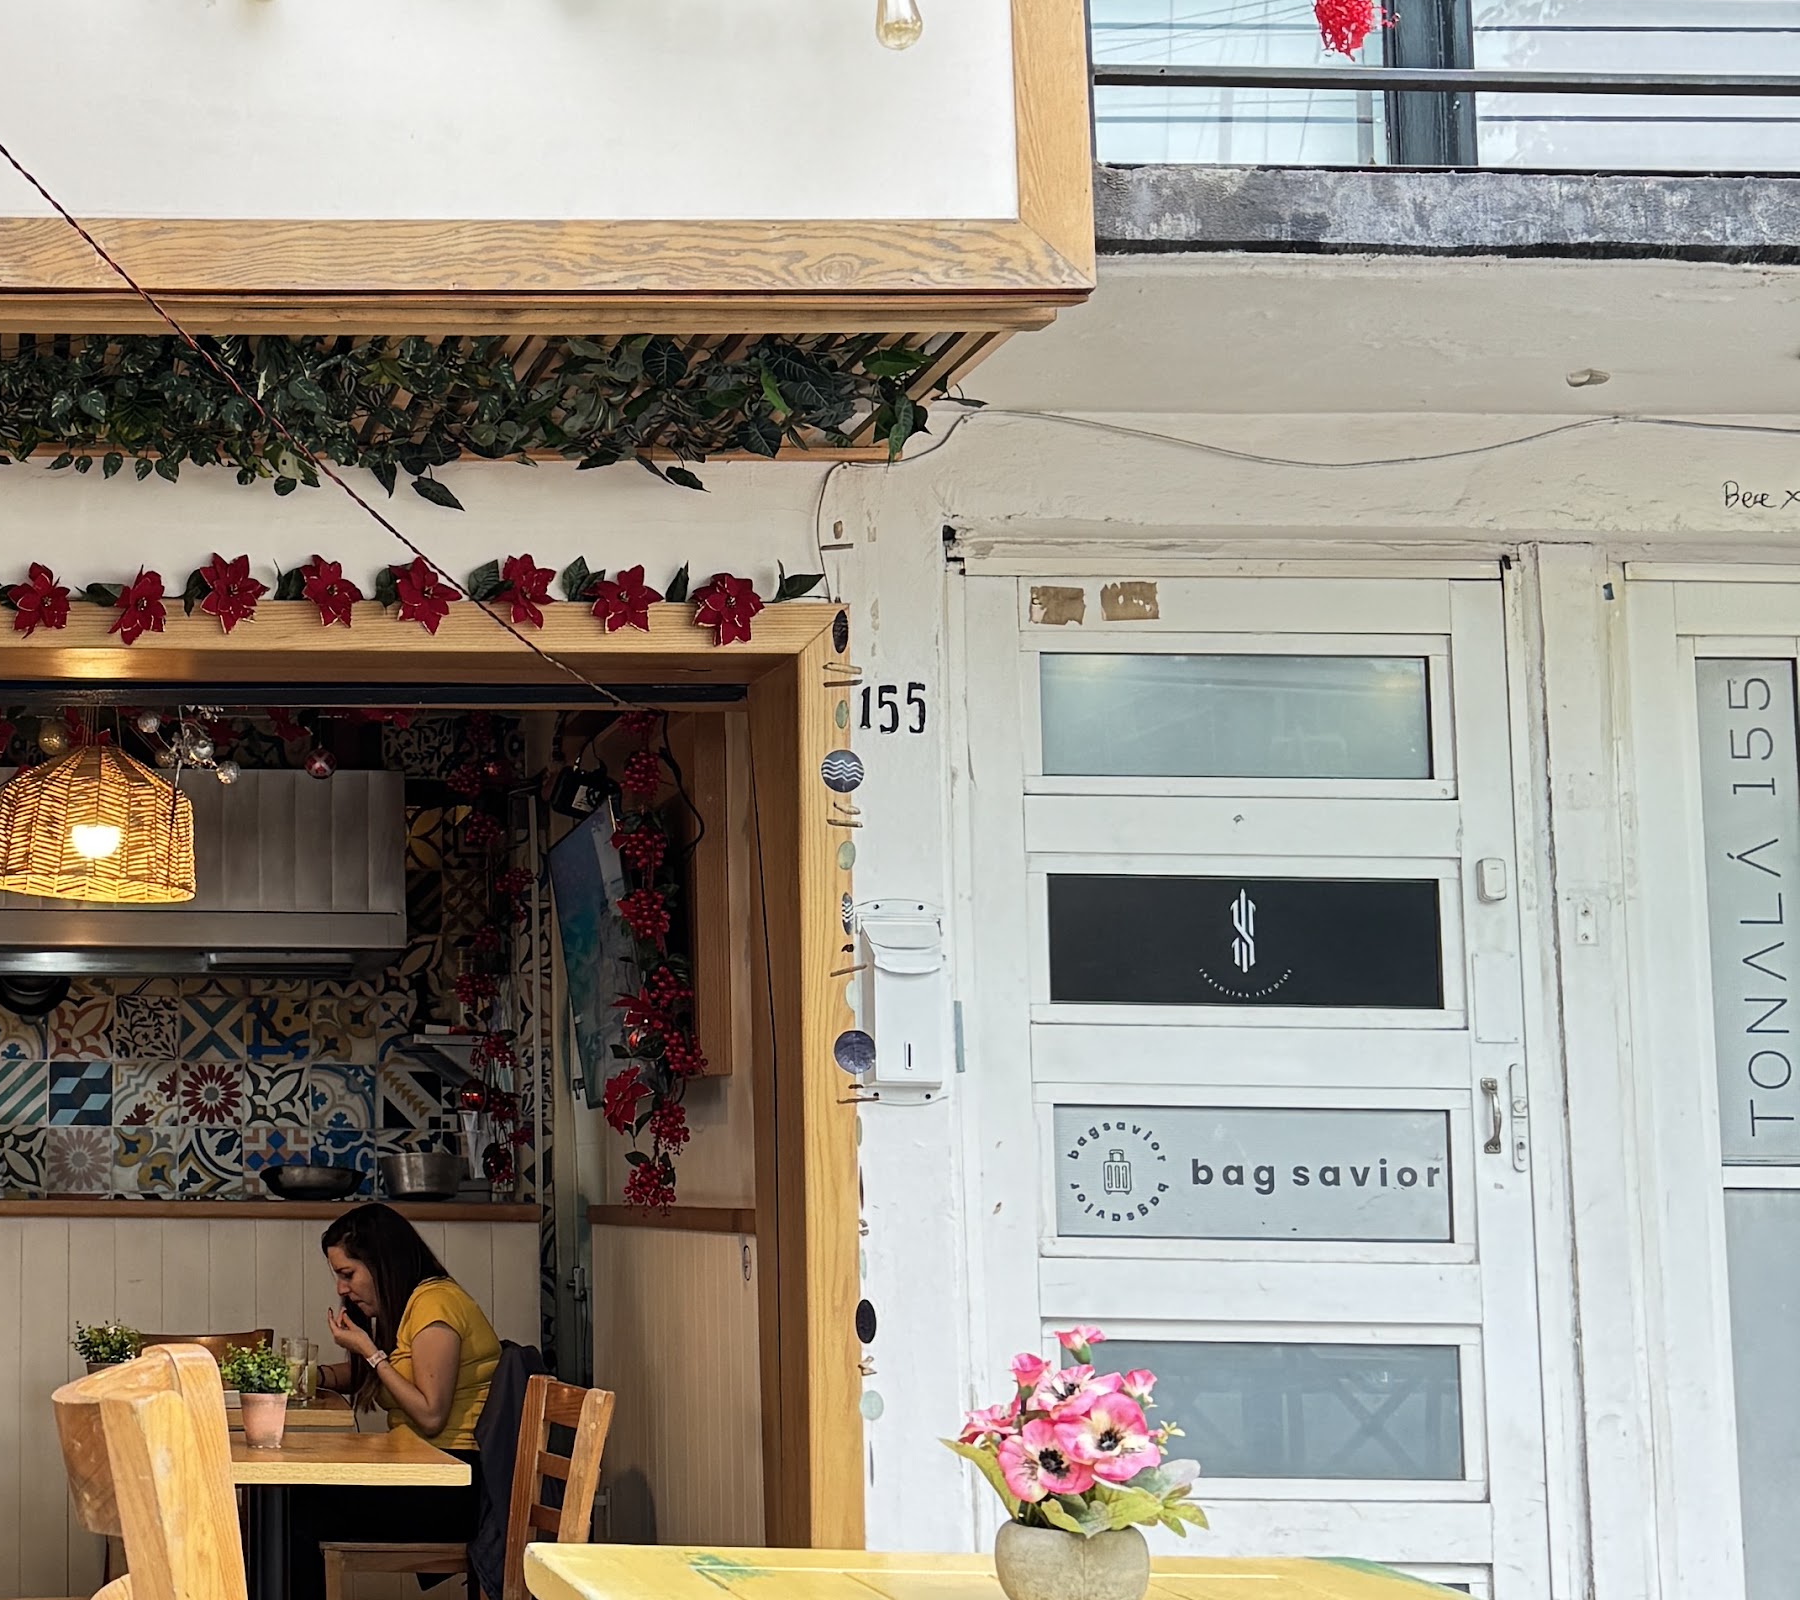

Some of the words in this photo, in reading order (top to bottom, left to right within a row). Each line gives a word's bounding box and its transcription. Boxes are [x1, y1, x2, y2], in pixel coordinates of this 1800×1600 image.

[859, 681, 927, 735] 155
[1726, 675, 1777, 797] 155
[1726, 837, 1795, 1138] TONALÁ
[1067, 1121, 1167, 1162] bagsavior
[1190, 1157, 1276, 1196] bag
[1291, 1157, 1441, 1188] savior
